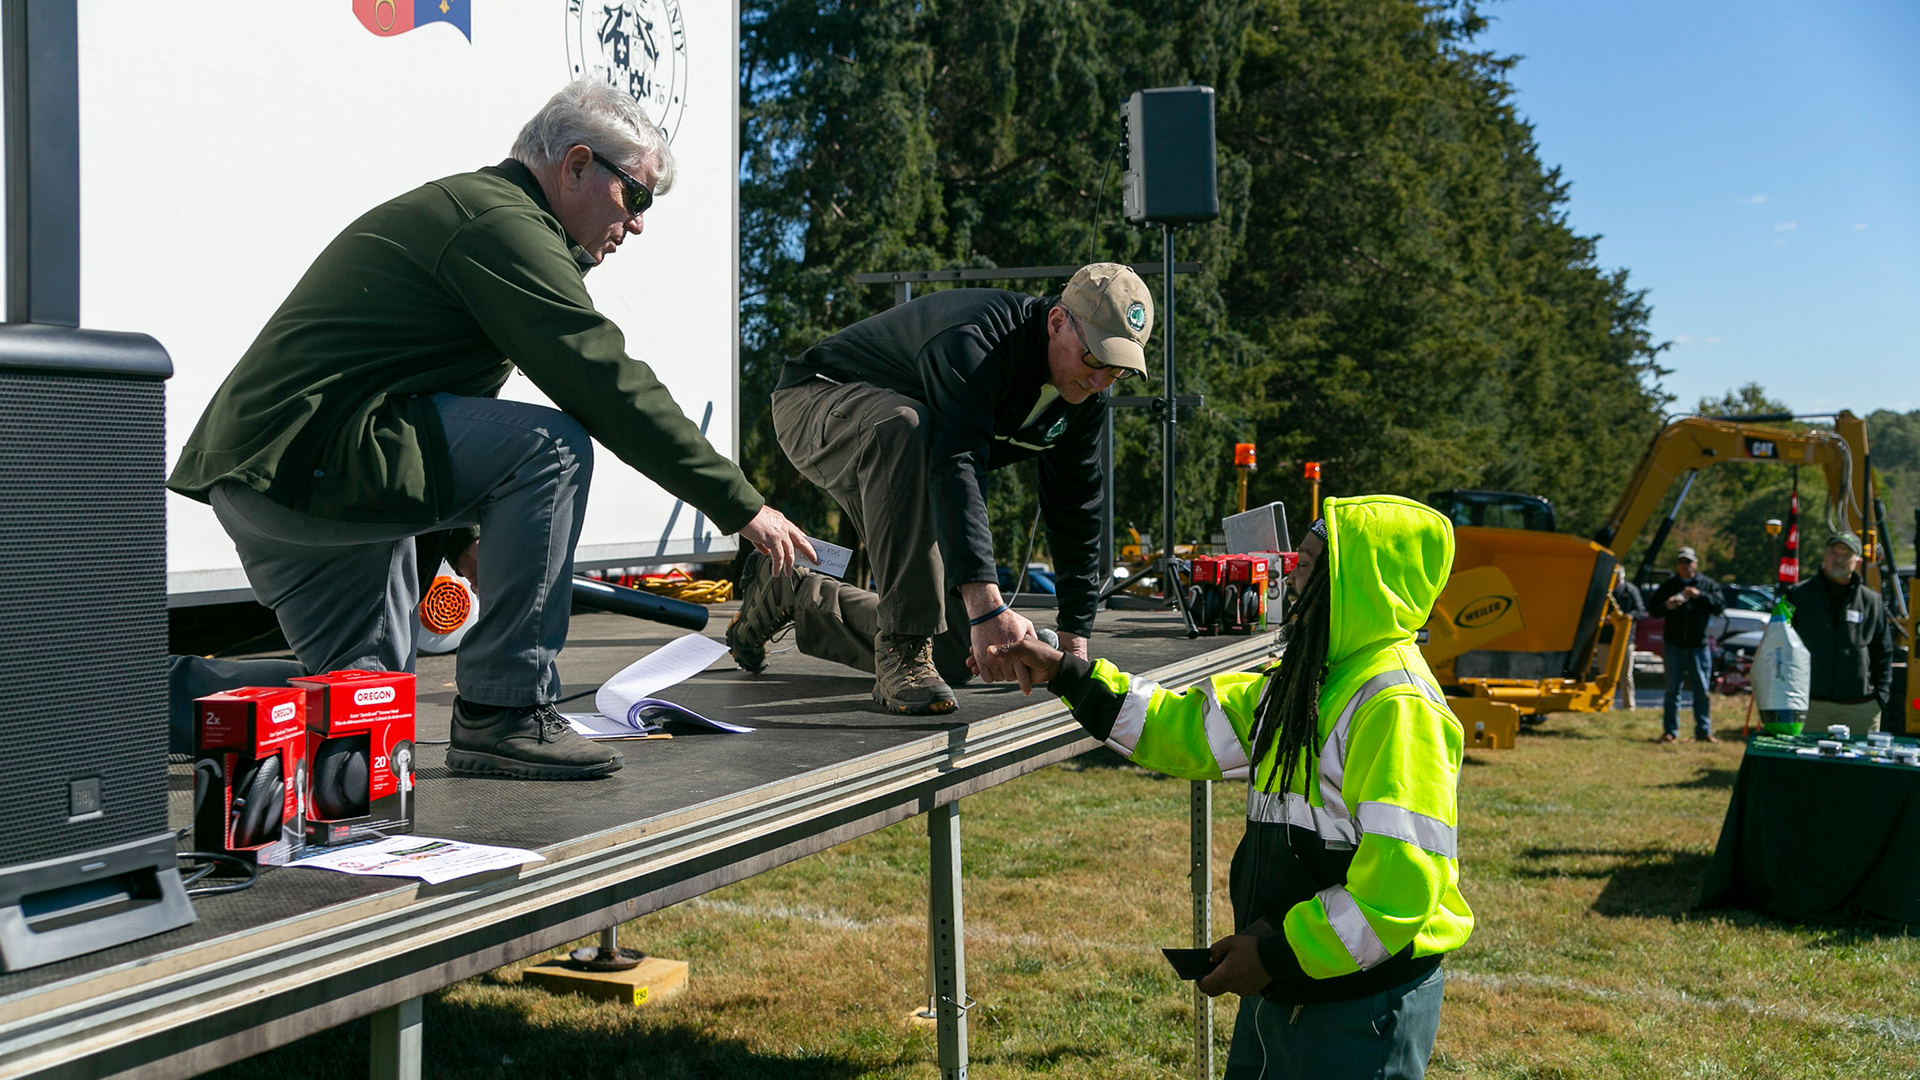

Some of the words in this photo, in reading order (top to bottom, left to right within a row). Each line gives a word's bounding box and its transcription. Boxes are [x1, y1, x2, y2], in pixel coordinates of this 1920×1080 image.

[1752, 441, 1774, 457] CAT
[1465, 601, 1501, 622] WEILER
[356, 690, 392, 702] OREGON
[205, 711, 220, 725] 2x
[374, 755, 387, 769] 20
